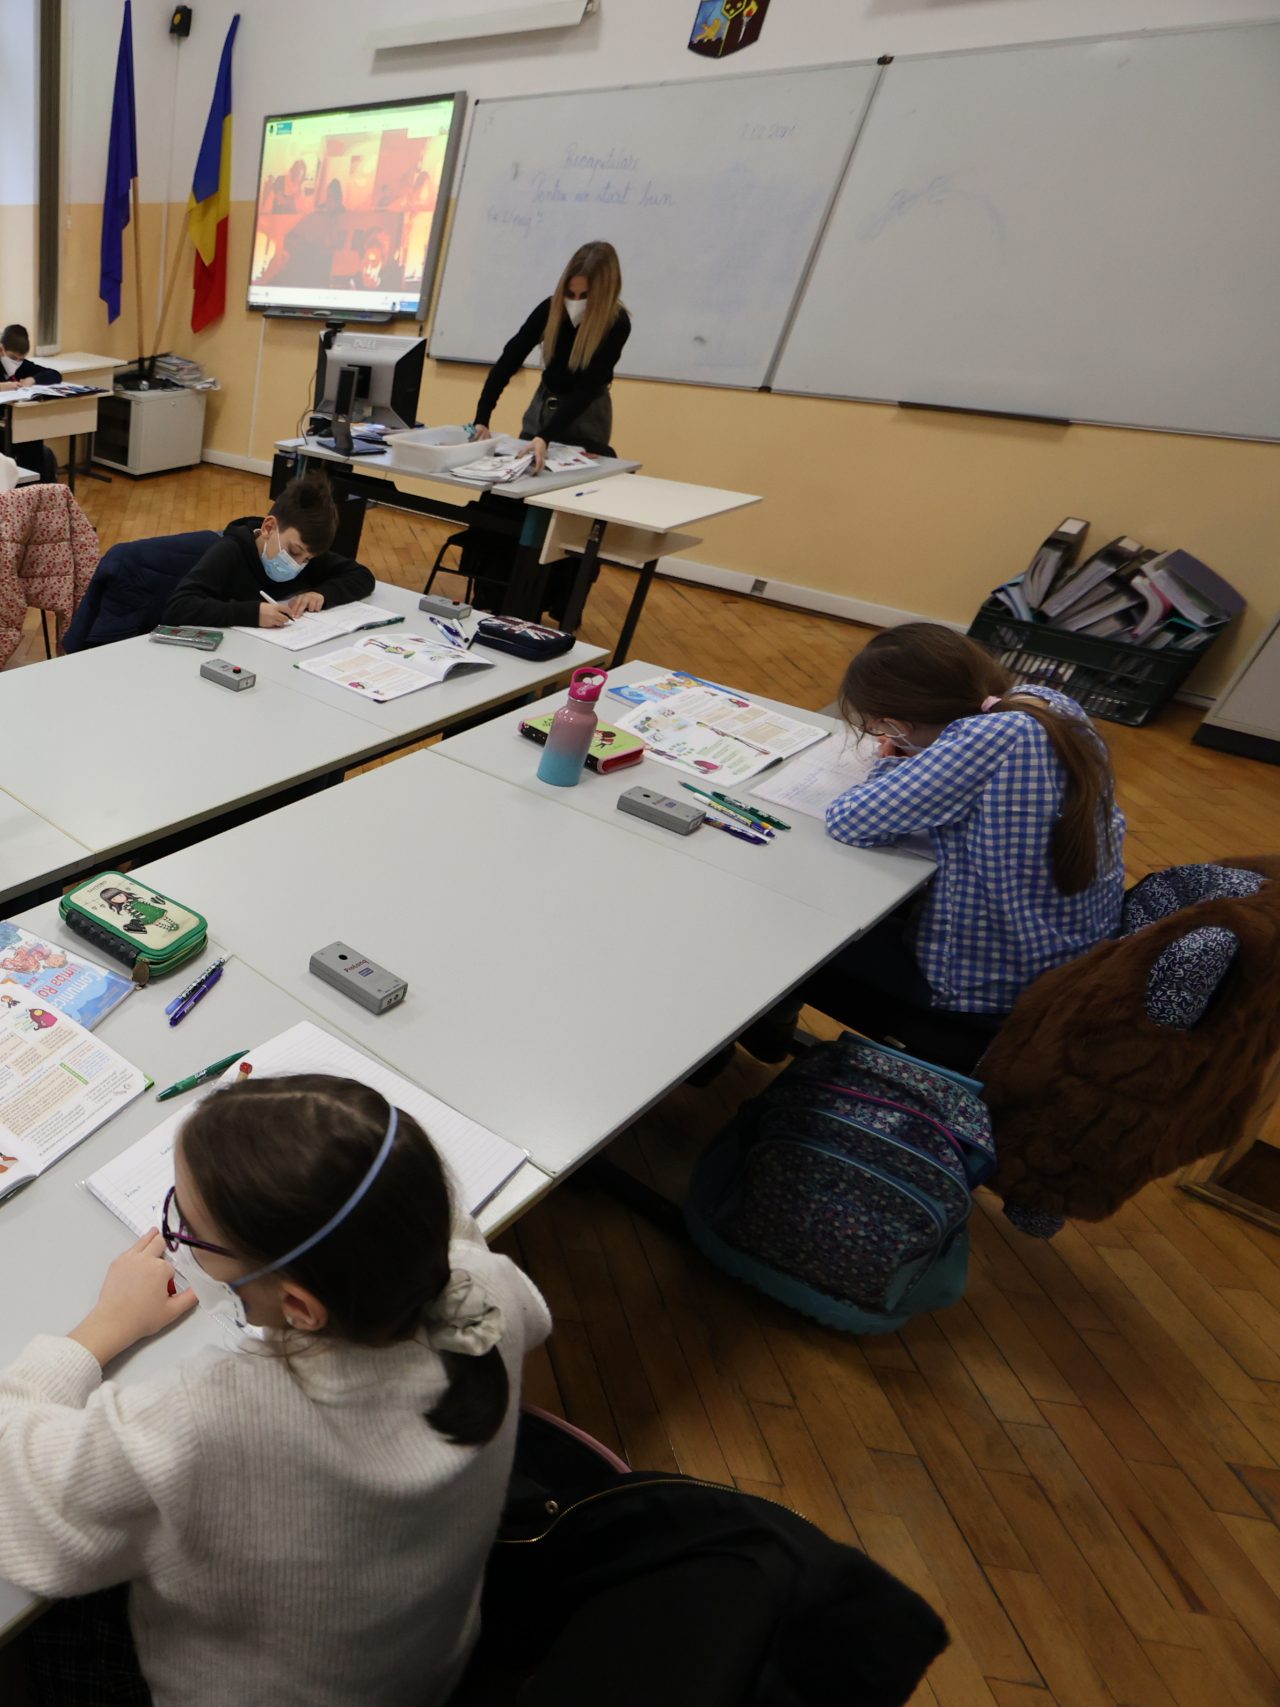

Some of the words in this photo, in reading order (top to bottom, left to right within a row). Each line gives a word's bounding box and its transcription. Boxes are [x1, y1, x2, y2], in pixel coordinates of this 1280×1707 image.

[639, 179, 674, 208] bun
[352, 338, 376, 348] DELL
[50, 963, 82, 987] Limba
